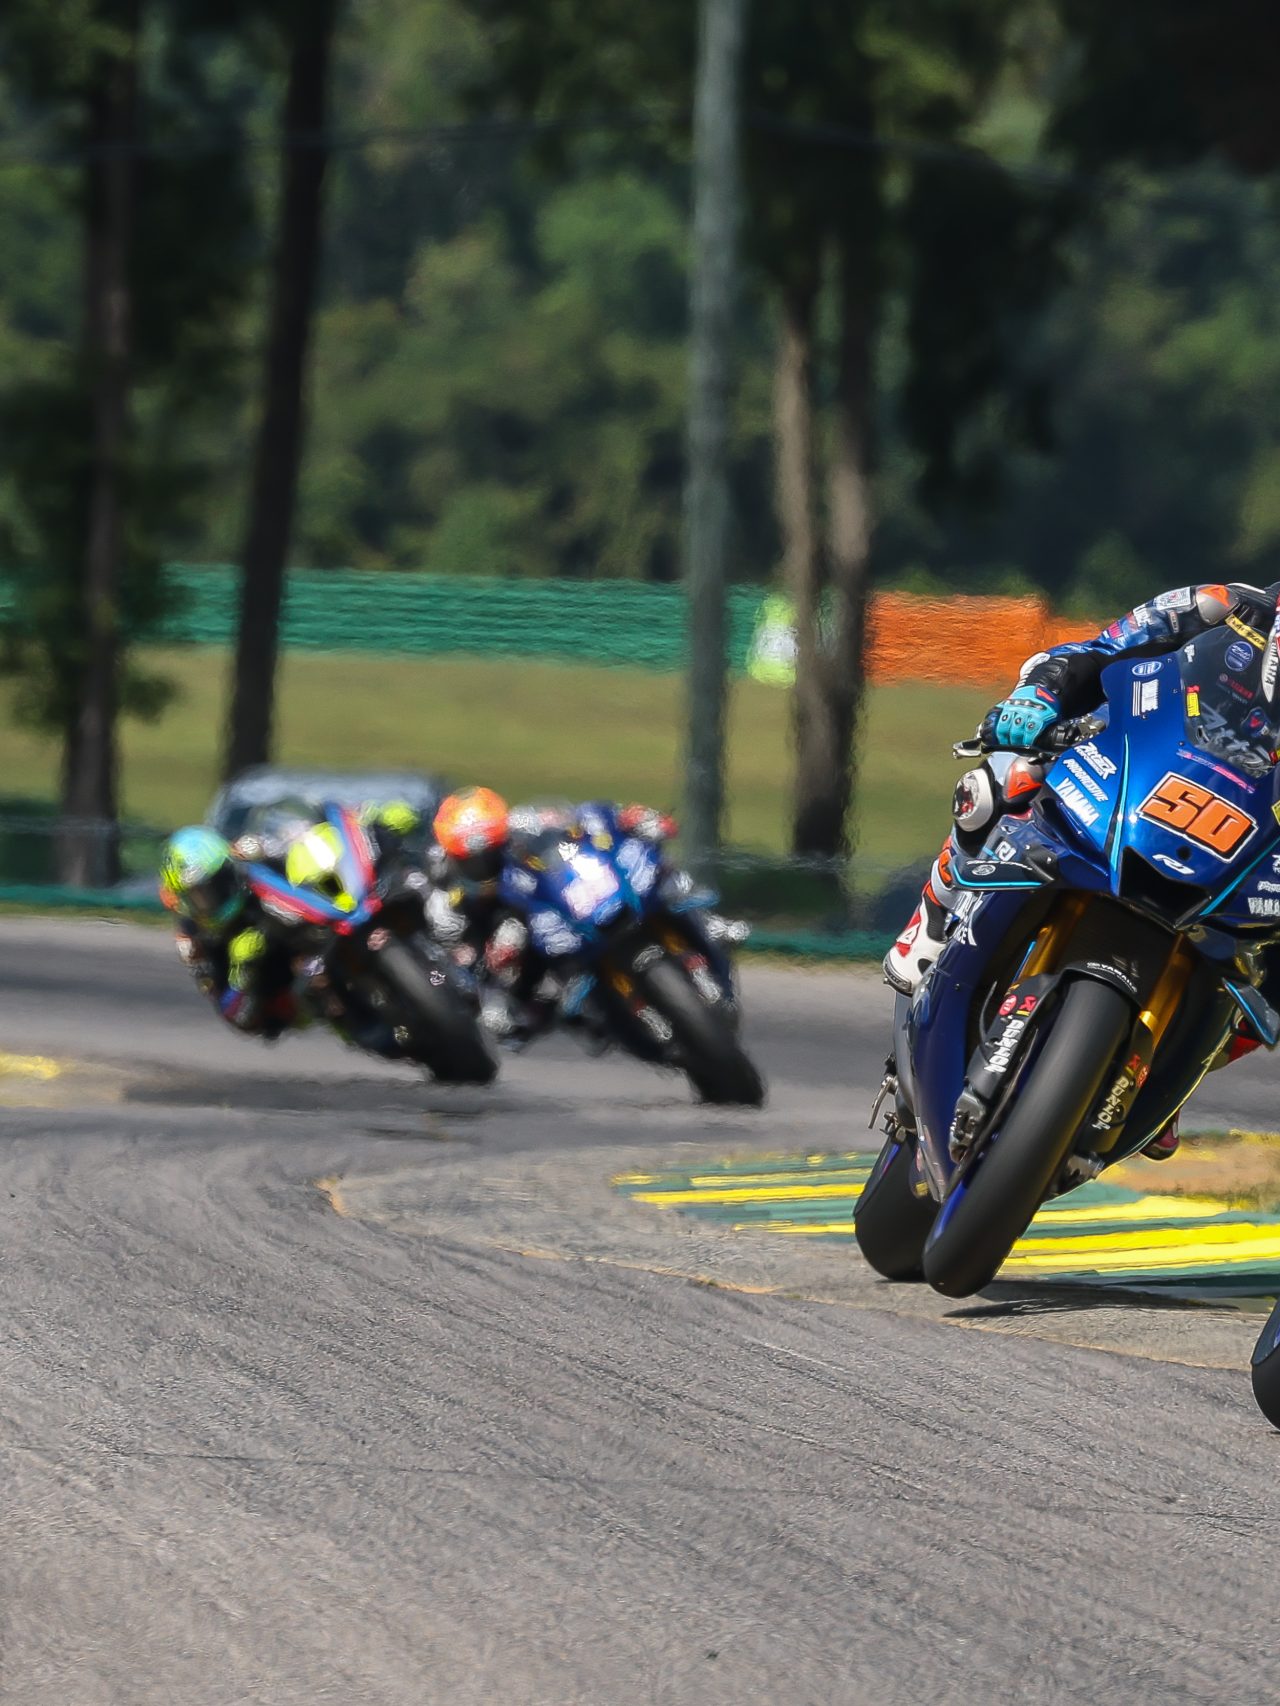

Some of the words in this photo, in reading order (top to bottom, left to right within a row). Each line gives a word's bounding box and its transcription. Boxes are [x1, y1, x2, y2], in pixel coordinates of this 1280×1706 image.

[1055, 777, 1100, 827] YAMAHA
[1063, 758, 1109, 802] PROGRESSIVE
[1139, 776, 1255, 858] 50
[1152, 853, 1195, 875] R1
